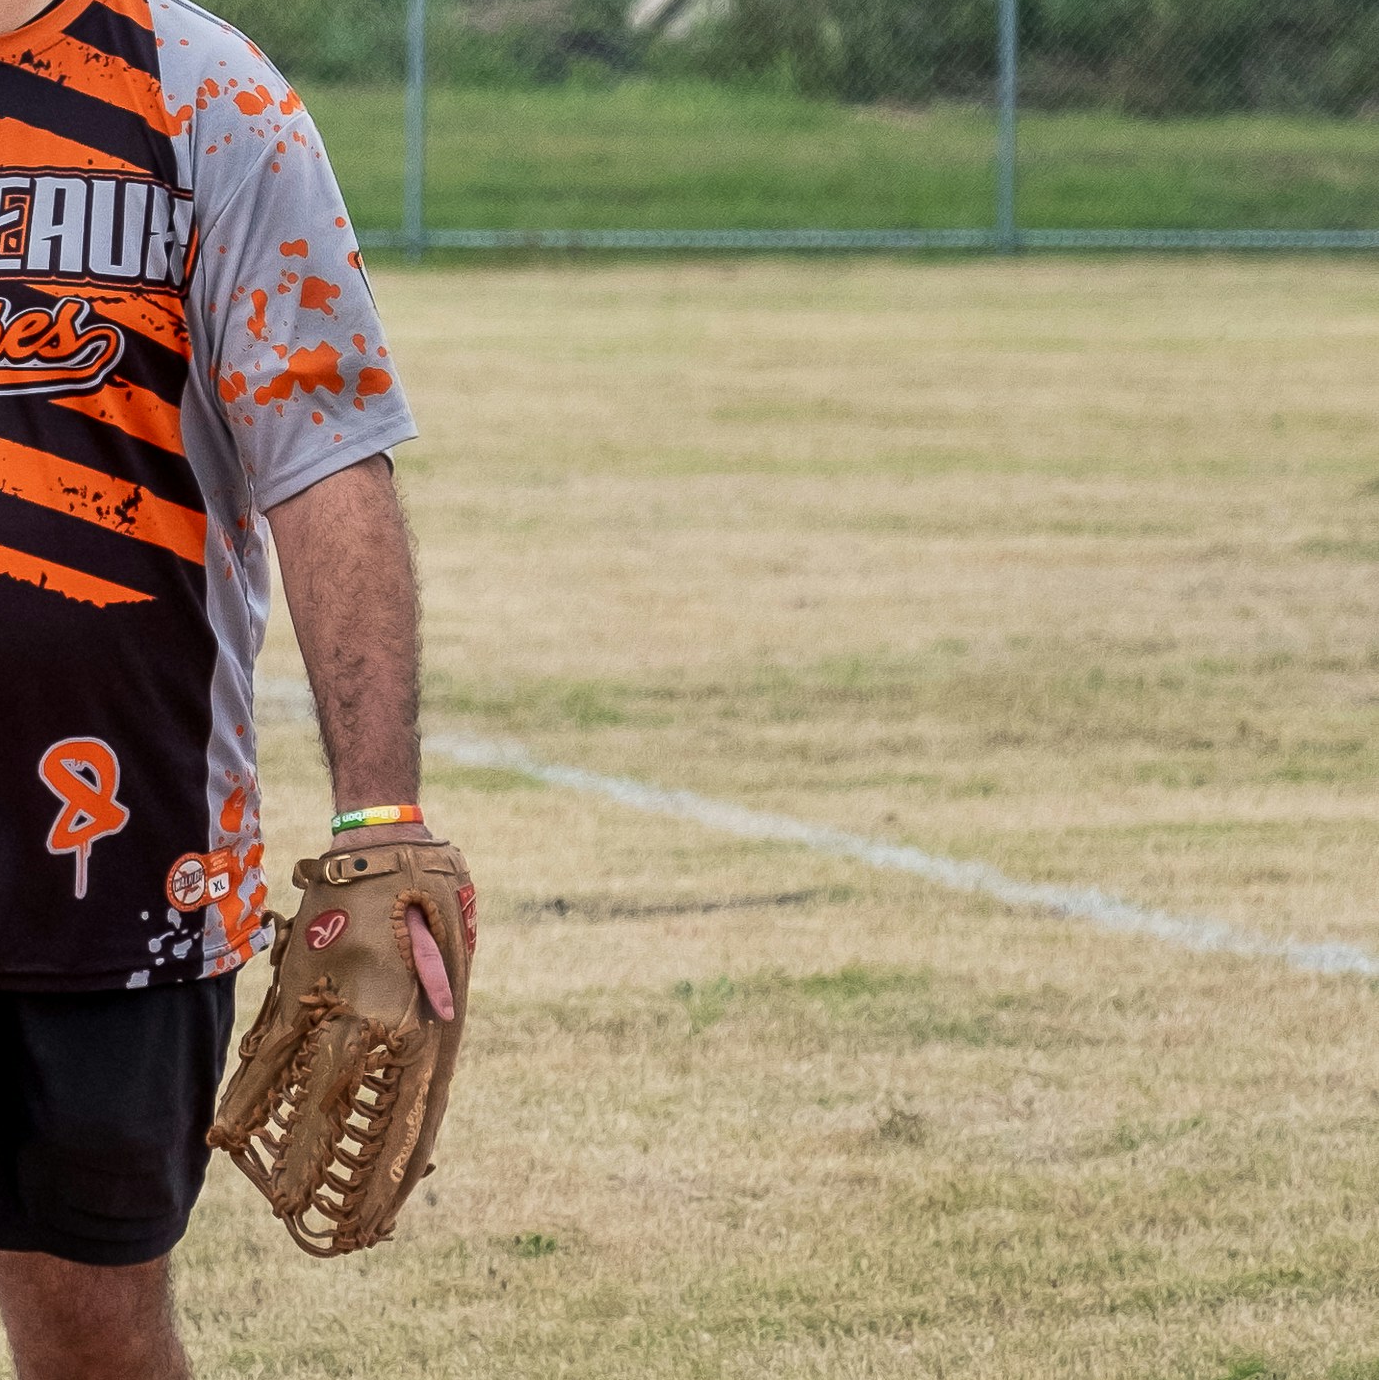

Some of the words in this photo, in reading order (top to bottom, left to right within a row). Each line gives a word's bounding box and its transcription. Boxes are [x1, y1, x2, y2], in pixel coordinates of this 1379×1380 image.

[40, 737, 129, 898] 8
[342, 808, 389, 823] Bourbon
[212, 878, 226, 893] XL
